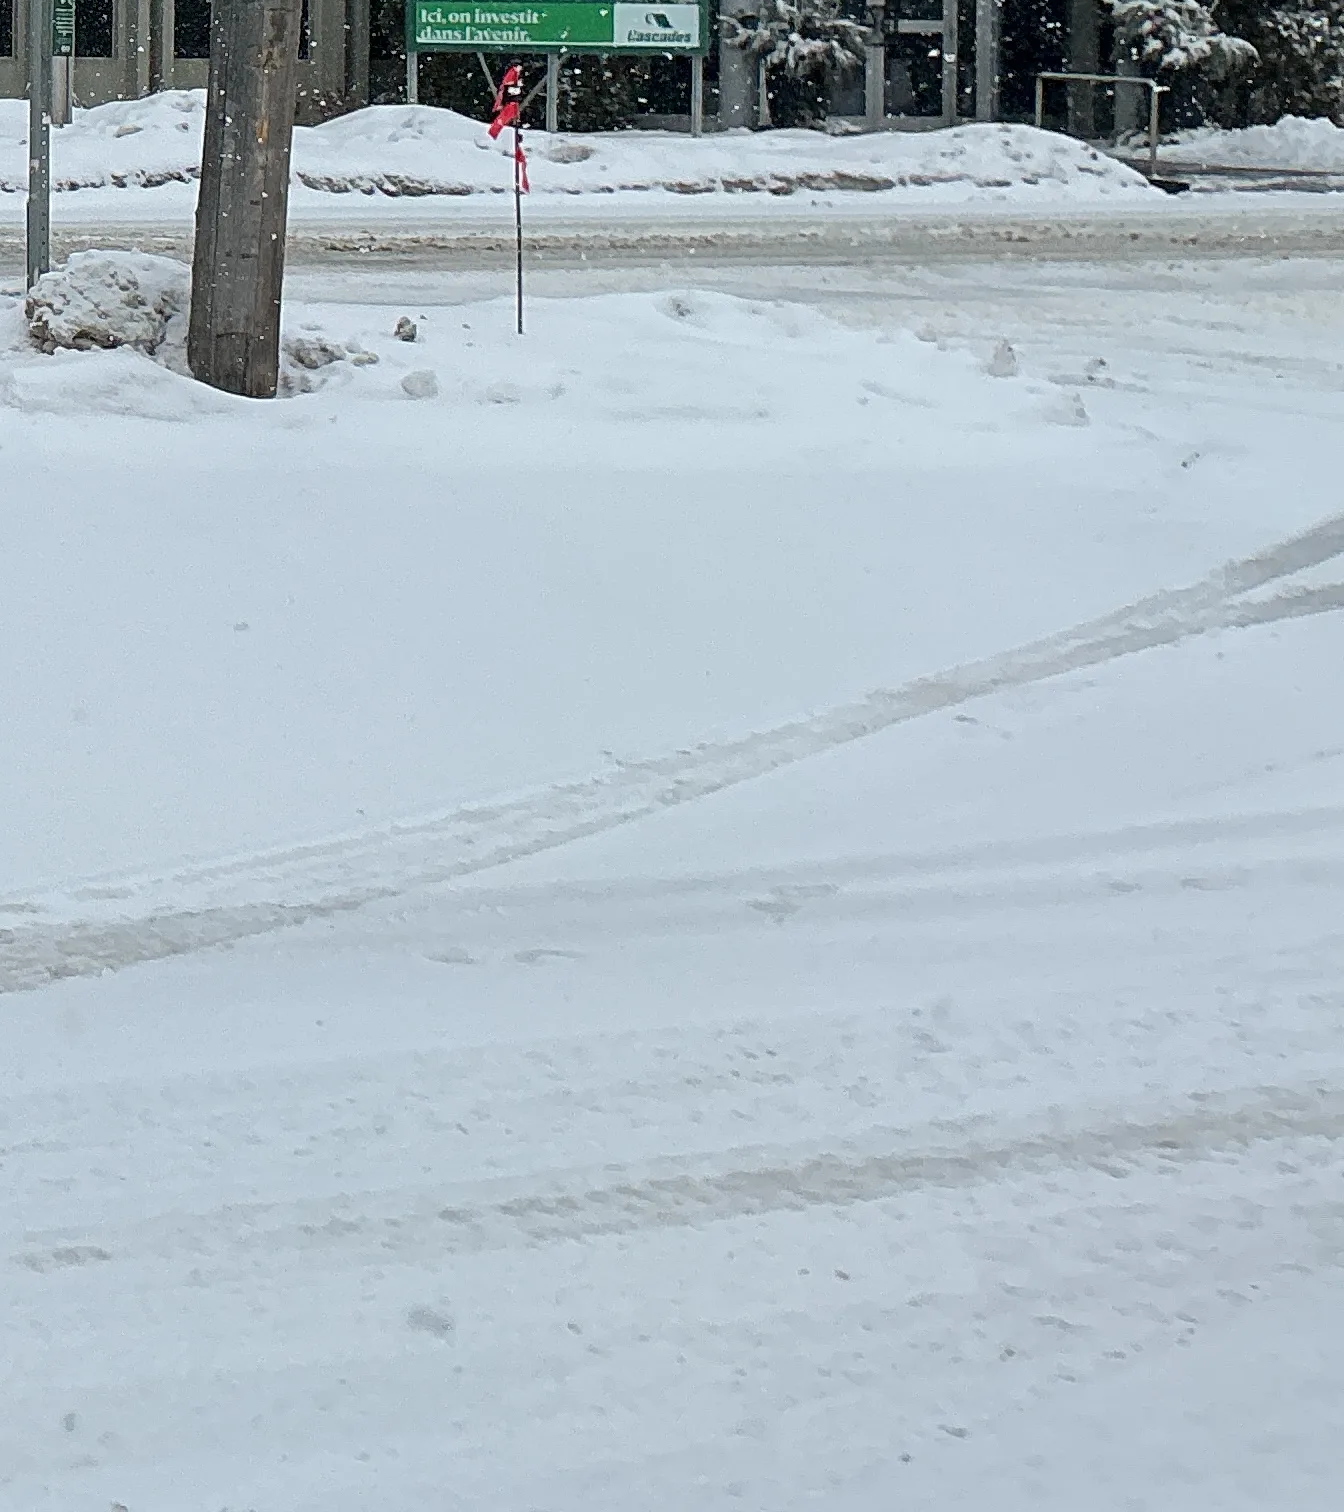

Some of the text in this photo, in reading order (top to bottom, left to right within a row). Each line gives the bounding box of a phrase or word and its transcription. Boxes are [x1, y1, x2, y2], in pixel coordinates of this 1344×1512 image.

[421, 8, 540, 24] Ici, on investit
[420, 26, 463, 40] dans
[627, 29, 692, 43] Cascades
